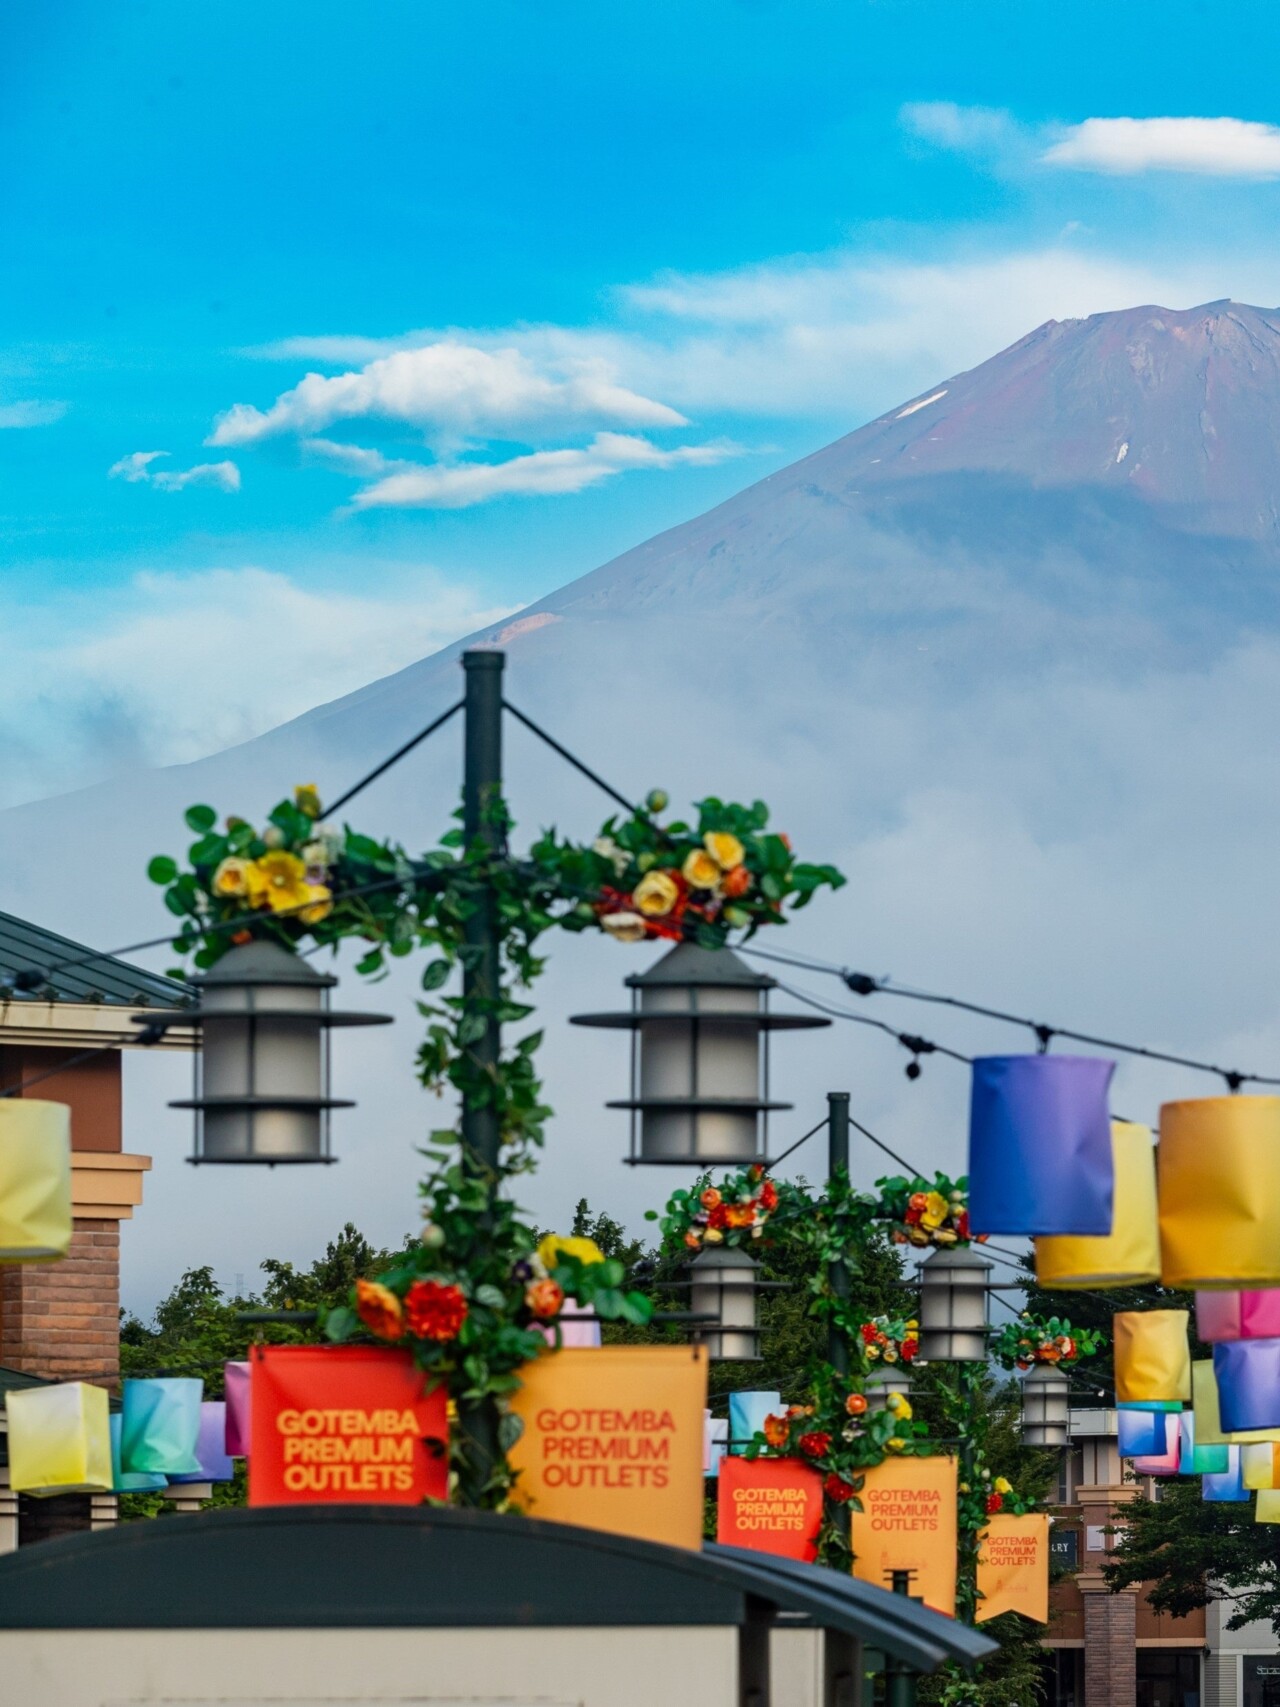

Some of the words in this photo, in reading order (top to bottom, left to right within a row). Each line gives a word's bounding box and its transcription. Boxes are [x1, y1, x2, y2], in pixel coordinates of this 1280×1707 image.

[277, 1409, 420, 1435] GOTEMBA
[536, 1409, 676, 1433] GOTEMBA
[284, 1437, 413, 1463] PREMIUM
[543, 1437, 669, 1460] PREMIUM
[284, 1465, 413, 1491] OUTLETS
[543, 1465, 669, 1488] OUTLETS
[732, 1488, 807, 1502] GOTEMBA
[867, 1489, 941, 1503] GOTEMBA
[736, 1502, 804, 1516] PREMIUM
[871, 1503, 938, 1517] PREMIUM
[736, 1516, 804, 1531] OUTLETS
[871, 1518, 938, 1531] OUTLETS
[987, 1536, 1038, 1546] GOTEMBA
[990, 1547, 1036, 1555] PREMIUM
[990, 1557, 1036, 1566] OUTLETS
